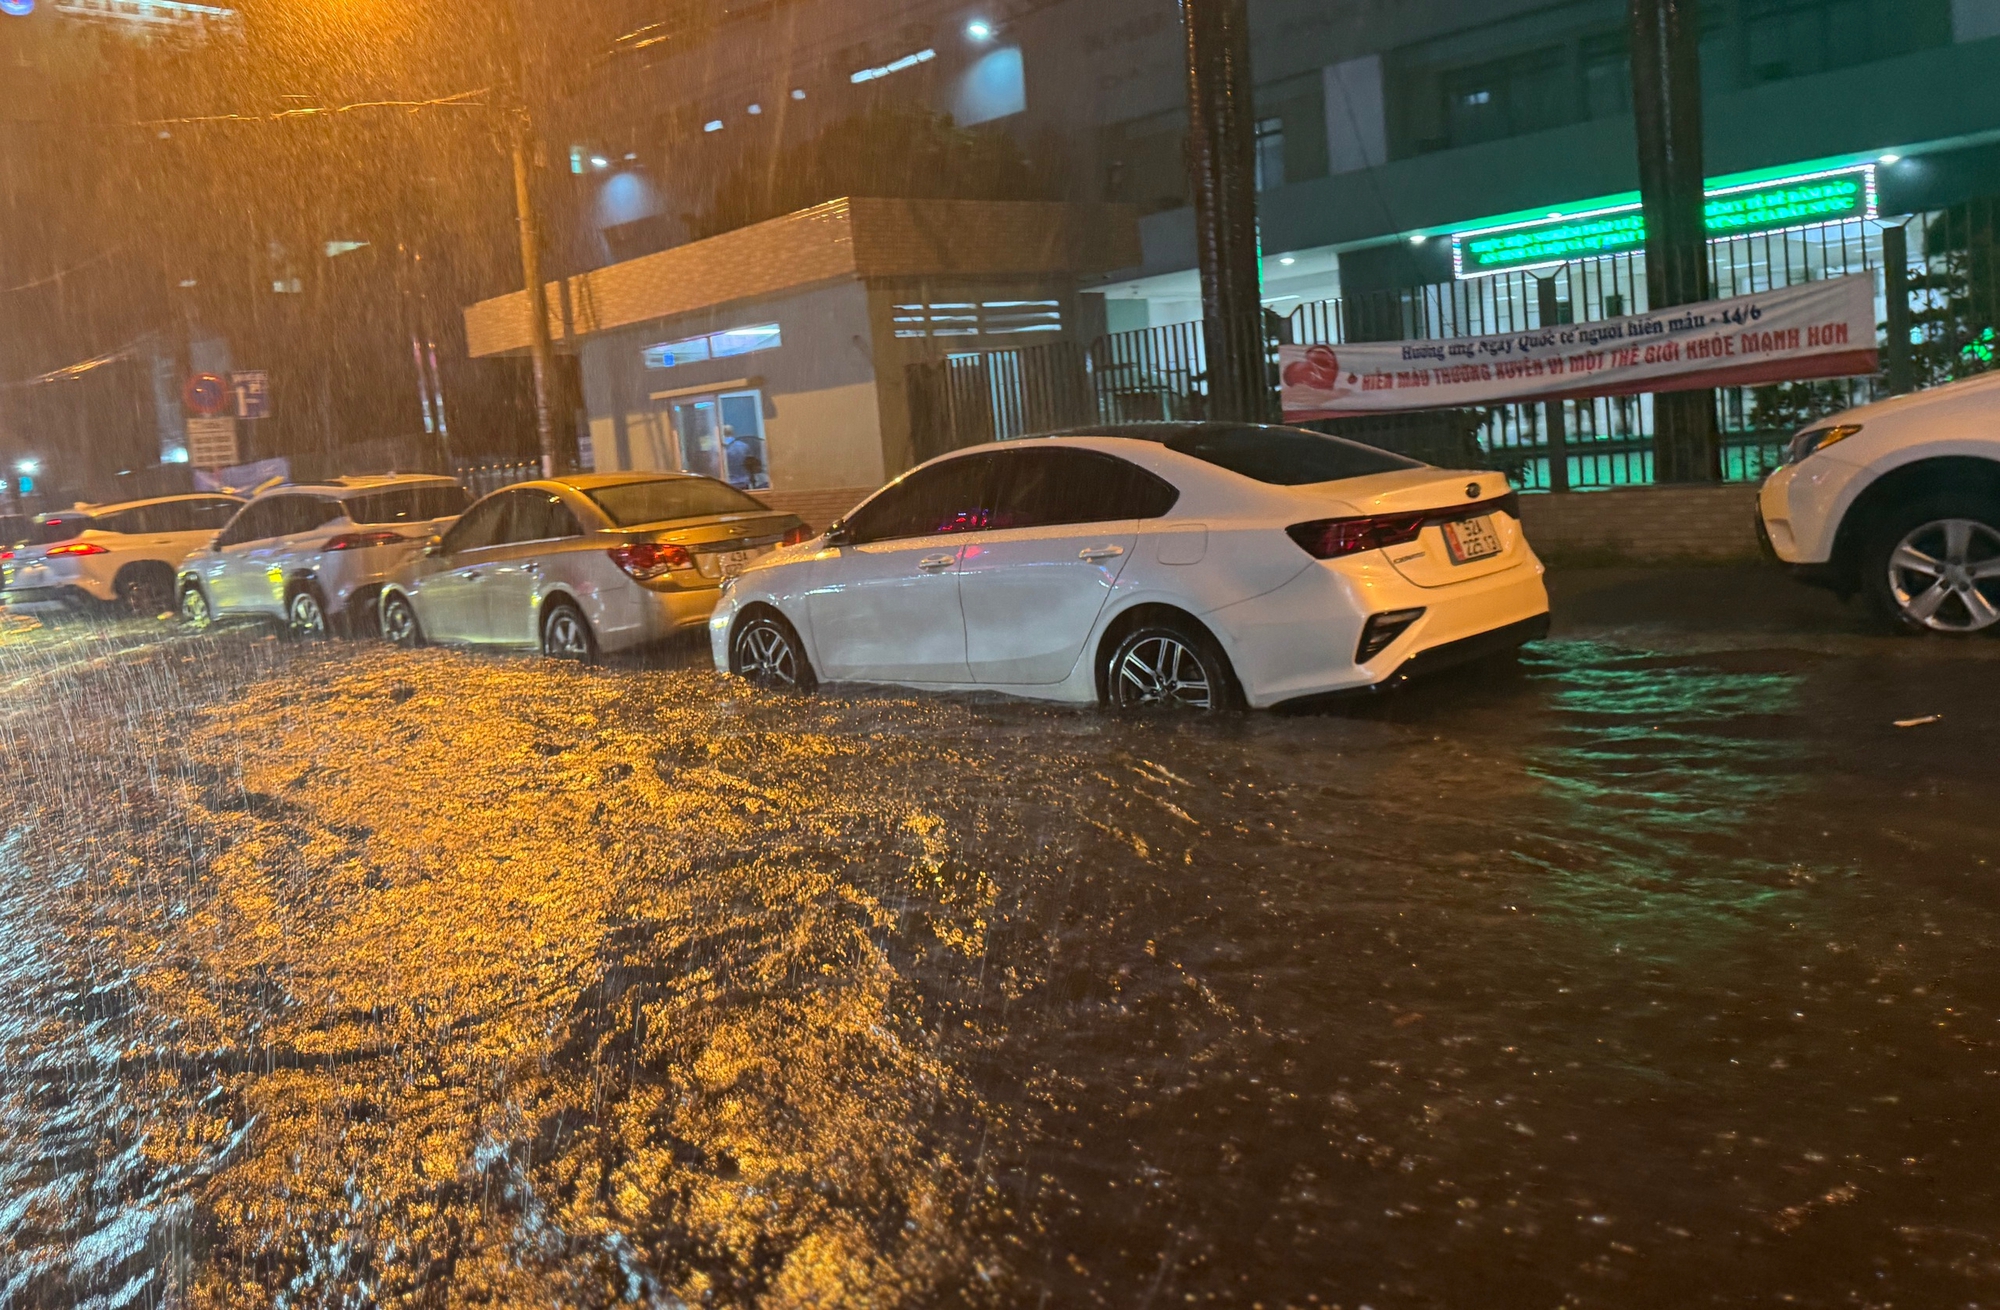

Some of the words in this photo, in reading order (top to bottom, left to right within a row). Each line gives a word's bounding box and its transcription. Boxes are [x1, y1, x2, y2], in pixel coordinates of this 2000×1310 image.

[1721, 304, 1762, 326] 14/6
[1570, 350, 1604, 375] MỘT
[1611, 343, 1640, 368] THẾ
[1741, 326, 1800, 357] MẠNH
[1807, 322, 1848, 347] HƠN
